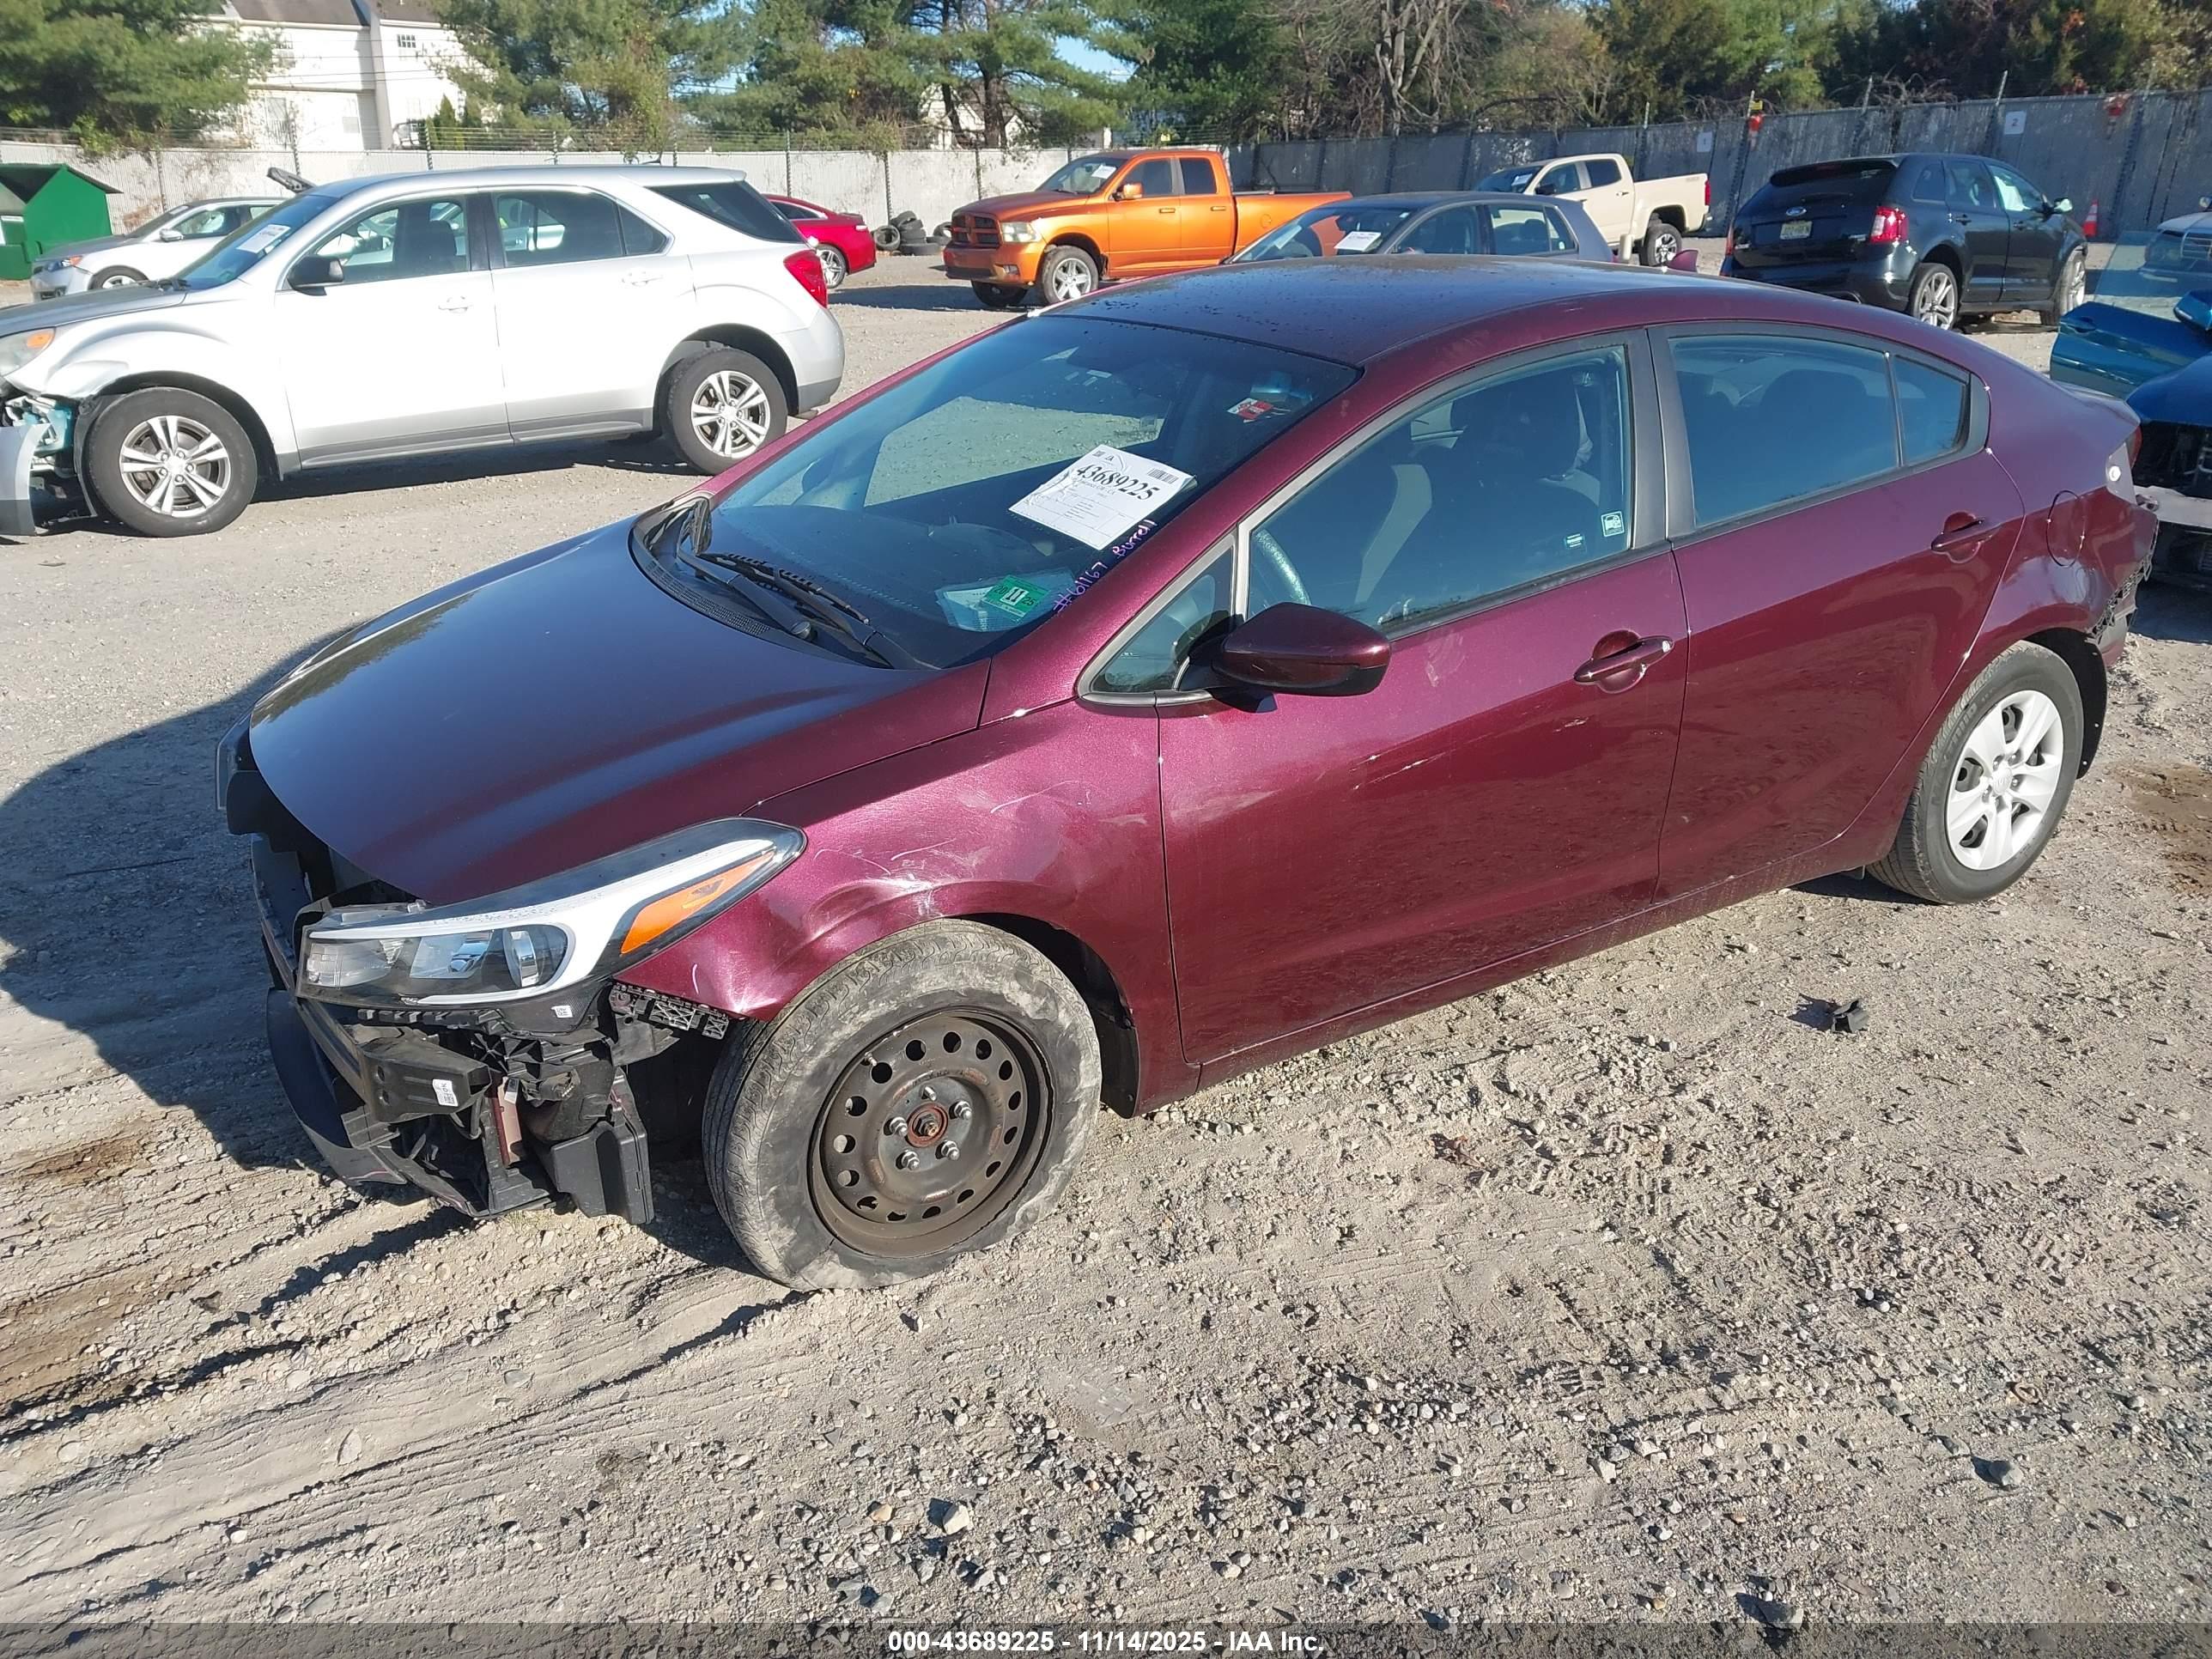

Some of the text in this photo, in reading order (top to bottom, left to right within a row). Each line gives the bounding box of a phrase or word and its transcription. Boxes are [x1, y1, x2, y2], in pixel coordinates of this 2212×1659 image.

[2011, 118, 2019, 127] 2
[1077, 464, 1160, 501] 43689225
[1112, 520, 1158, 558] Burrell
[994, 585, 1036, 606] 20 11 25
